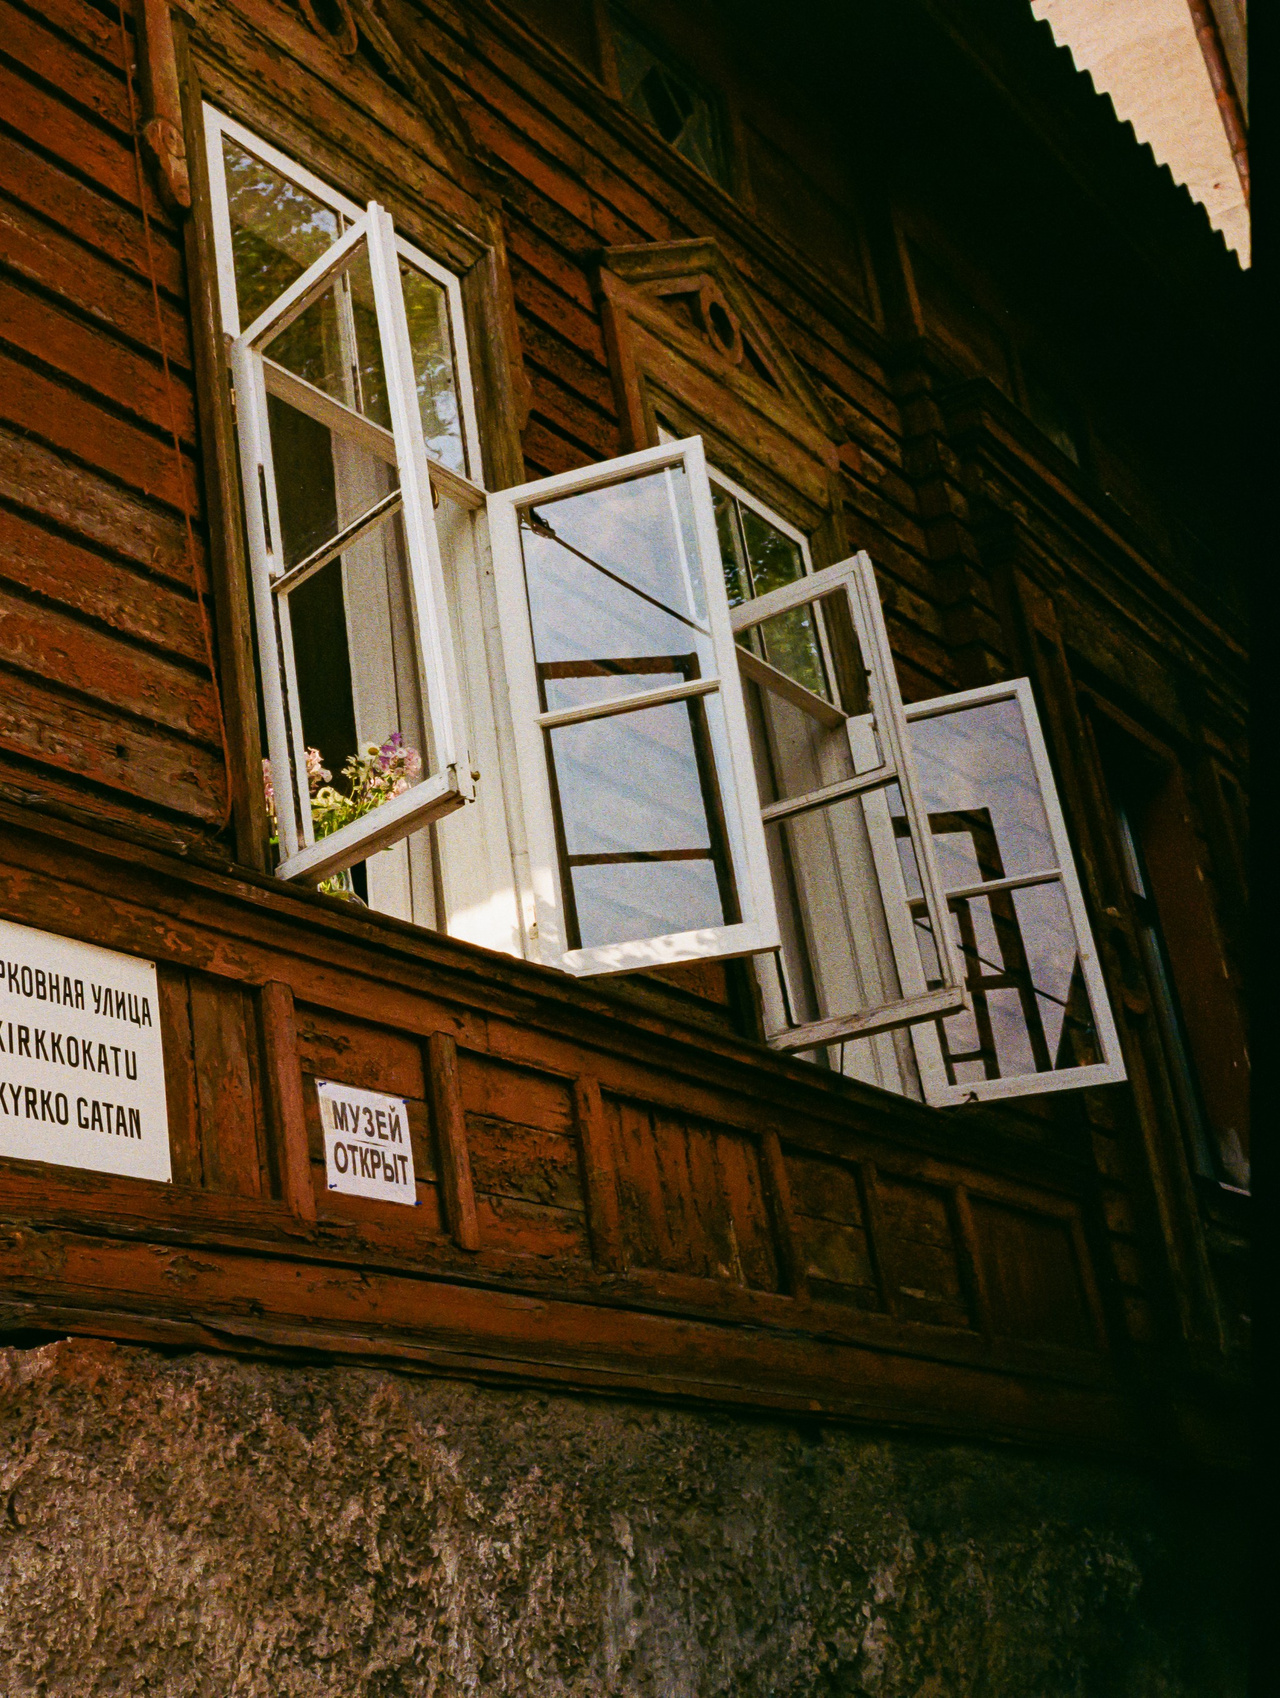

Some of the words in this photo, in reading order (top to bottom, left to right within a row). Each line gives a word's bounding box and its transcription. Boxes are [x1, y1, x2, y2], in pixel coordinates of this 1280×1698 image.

[91, 983, 152, 1029] УЛИЦА
[76, 1097, 142, 1140] GATAN
[332, 1100, 403, 1144] МУЗЕЙ
[333, 1141, 409, 1186] ОТКРЫТ
